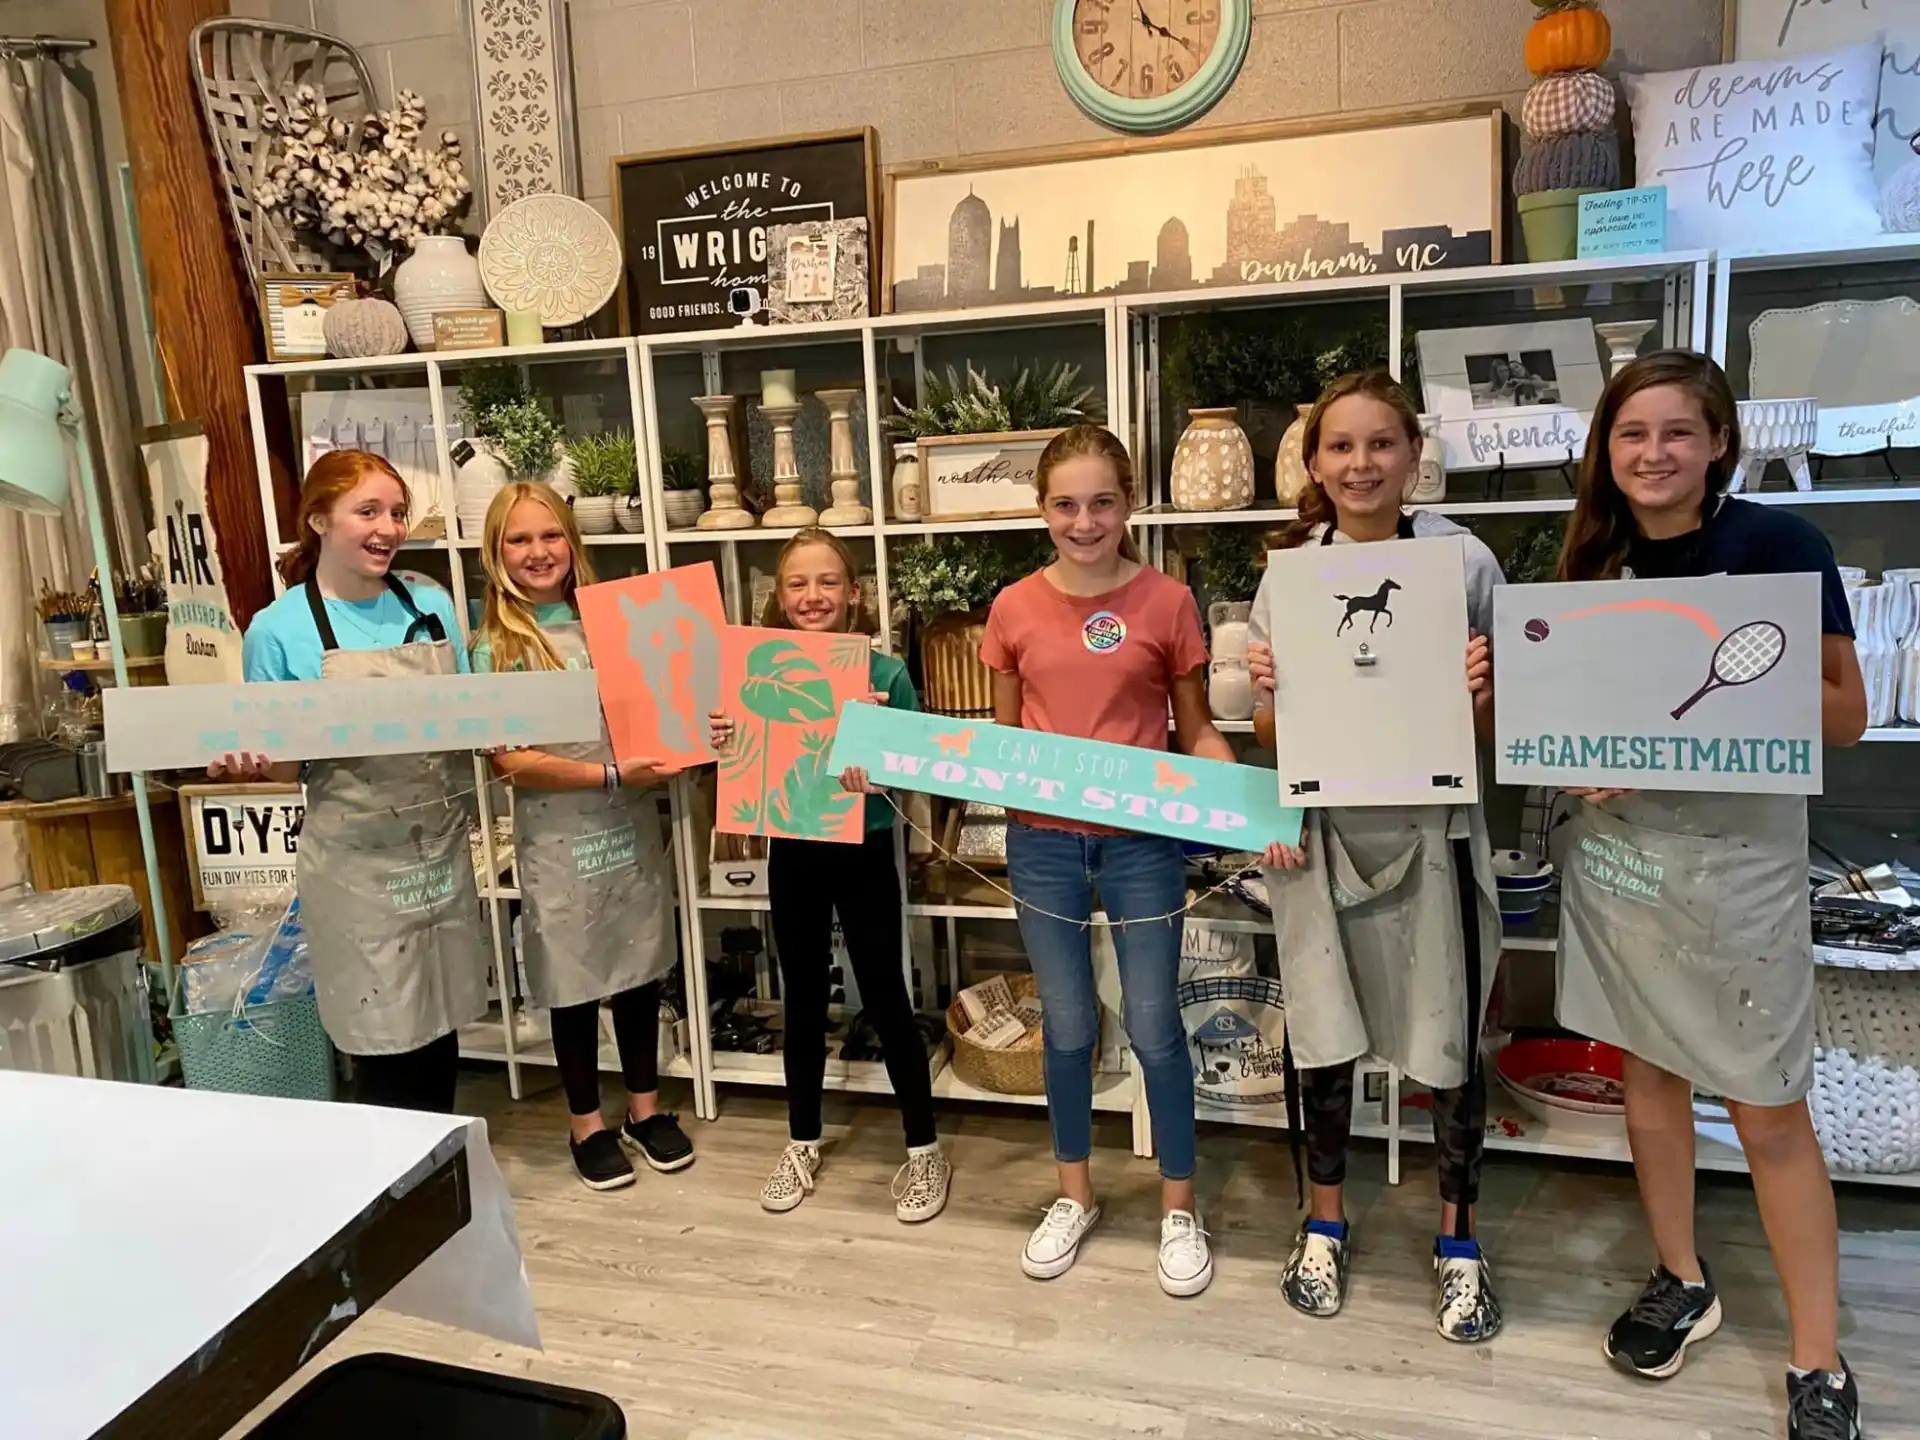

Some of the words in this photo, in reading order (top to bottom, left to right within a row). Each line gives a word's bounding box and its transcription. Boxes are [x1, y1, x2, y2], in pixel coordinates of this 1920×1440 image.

[1140, 63, 1154, 94] 6
[1674, 61, 1843, 110] dreams
[1664, 113, 1724, 148] ARE
[1752, 100, 1852, 134] MADE
[1656, 137, 1815, 210] here
[685, 172, 771, 209] WELCOME
[780, 176, 802, 198] TO
[720, 197, 769, 221] the
[672, 226, 767, 270] WRIG
[710, 266, 768, 288] hom
[1240, 249, 1377, 282] Durham,
[649, 307, 675, 320] GOOD
[678, 302, 724, 317] FRIENDS.
[1467, 415, 1582, 463] friends
[937, 460, 1010, 484] north
[998, 739, 1062, 769] CAN'T
[1075, 753, 1128, 780] STOP
[1506, 734, 1811, 775] #GAMESETMATCH
[881, 751, 1066, 800] WON'T
[1082, 787, 1248, 832] STOP
[203, 872, 222, 885] FUN
[224, 871, 240, 884] DIY
[268, 869, 288, 884] FOR
[577, 854, 604, 872] PLAY
[392, 889, 423, 907] PLAY
[1614, 871, 1661, 897] hard
